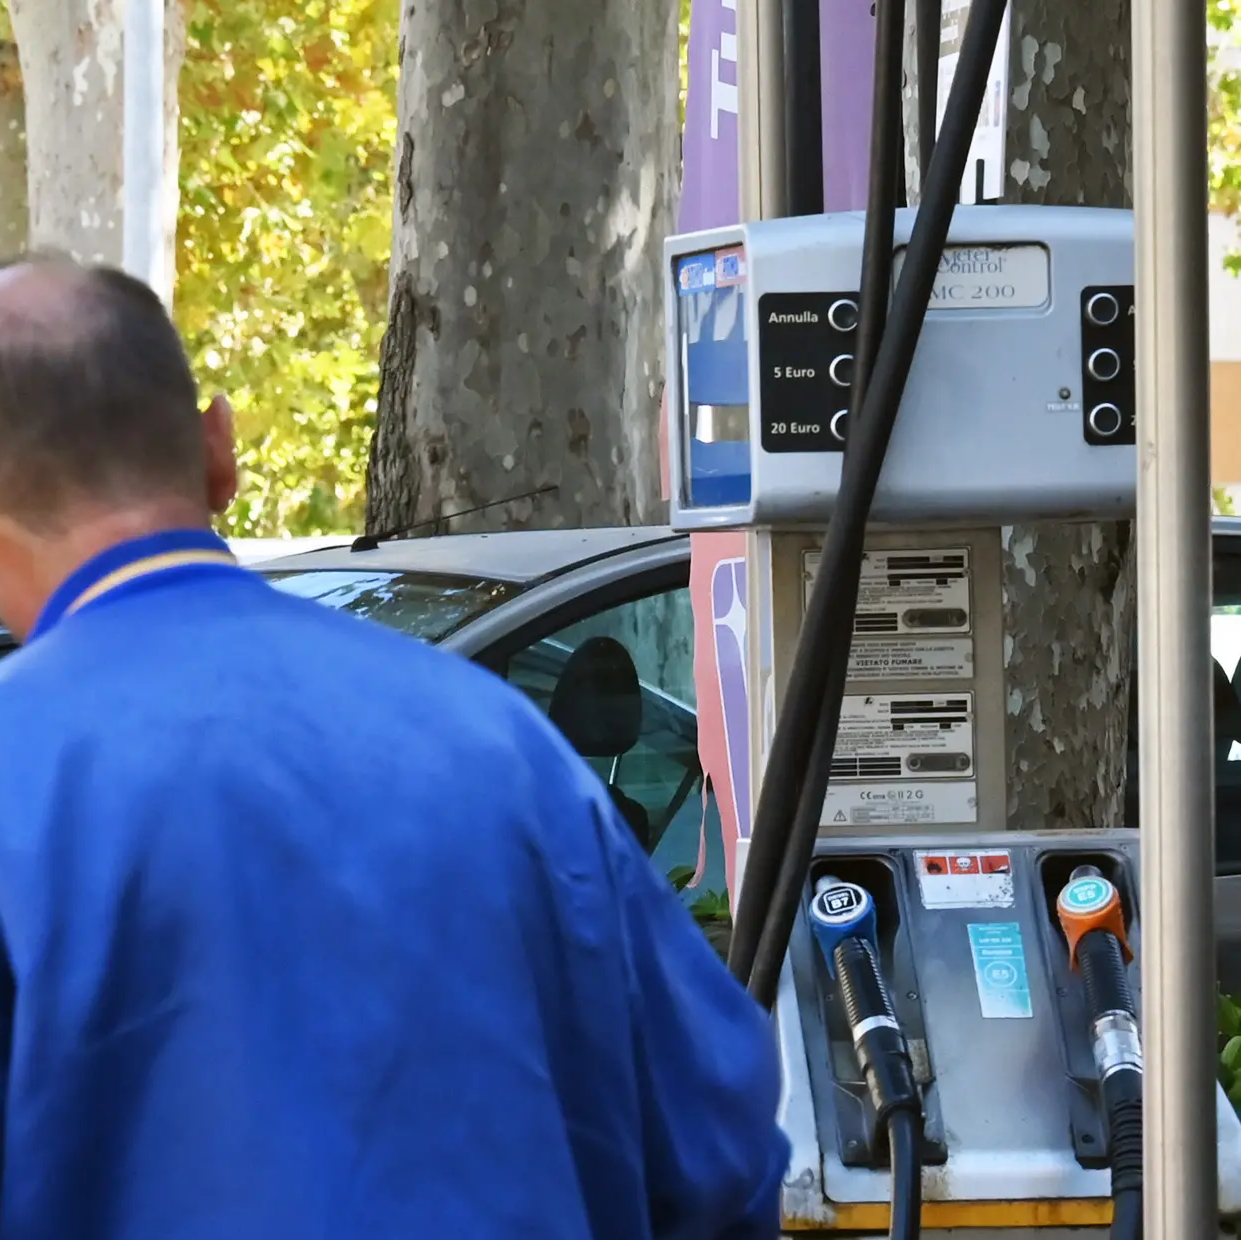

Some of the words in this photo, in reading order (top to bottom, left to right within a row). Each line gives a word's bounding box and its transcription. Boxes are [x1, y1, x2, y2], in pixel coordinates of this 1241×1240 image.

[971, 284, 1016, 299] 200
[768, 311, 820, 324] Annulla
[773, 366, 782, 379] 5
[785, 366, 817, 379] Euro
[771, 422, 787, 435] 20
[790, 422, 821, 435] Euro
